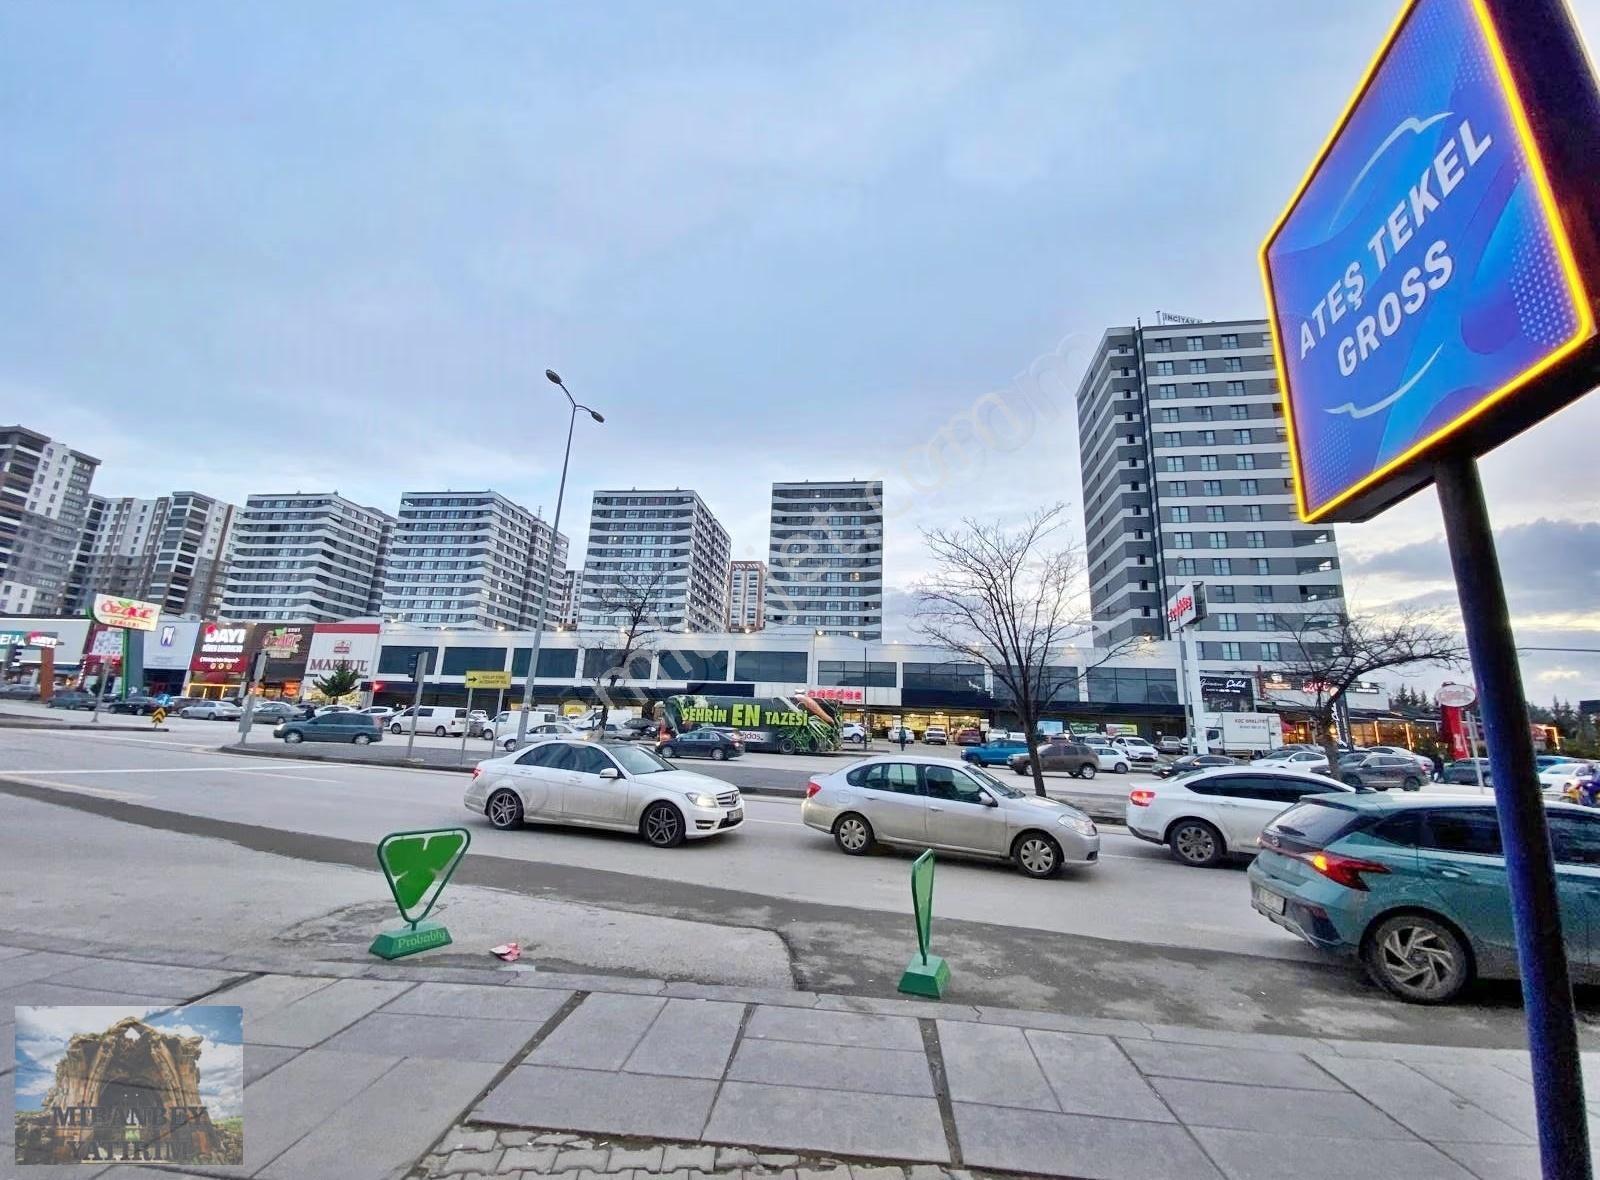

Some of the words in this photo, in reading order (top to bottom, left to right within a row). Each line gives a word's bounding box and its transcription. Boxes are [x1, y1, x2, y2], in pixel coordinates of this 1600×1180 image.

[1299, 259, 1366, 361] ATEŞ
[1367, 119, 1493, 274] TEKEL
[1336, 239, 1455, 378] GROSS
[205, 629, 247, 644] DAYI
[310, 659, 369, 672] MAKBUL
[732, 704, 760, 726] EN
[765, 711, 808, 726] TAZESİ
[398, 929, 445, 948] Probably
